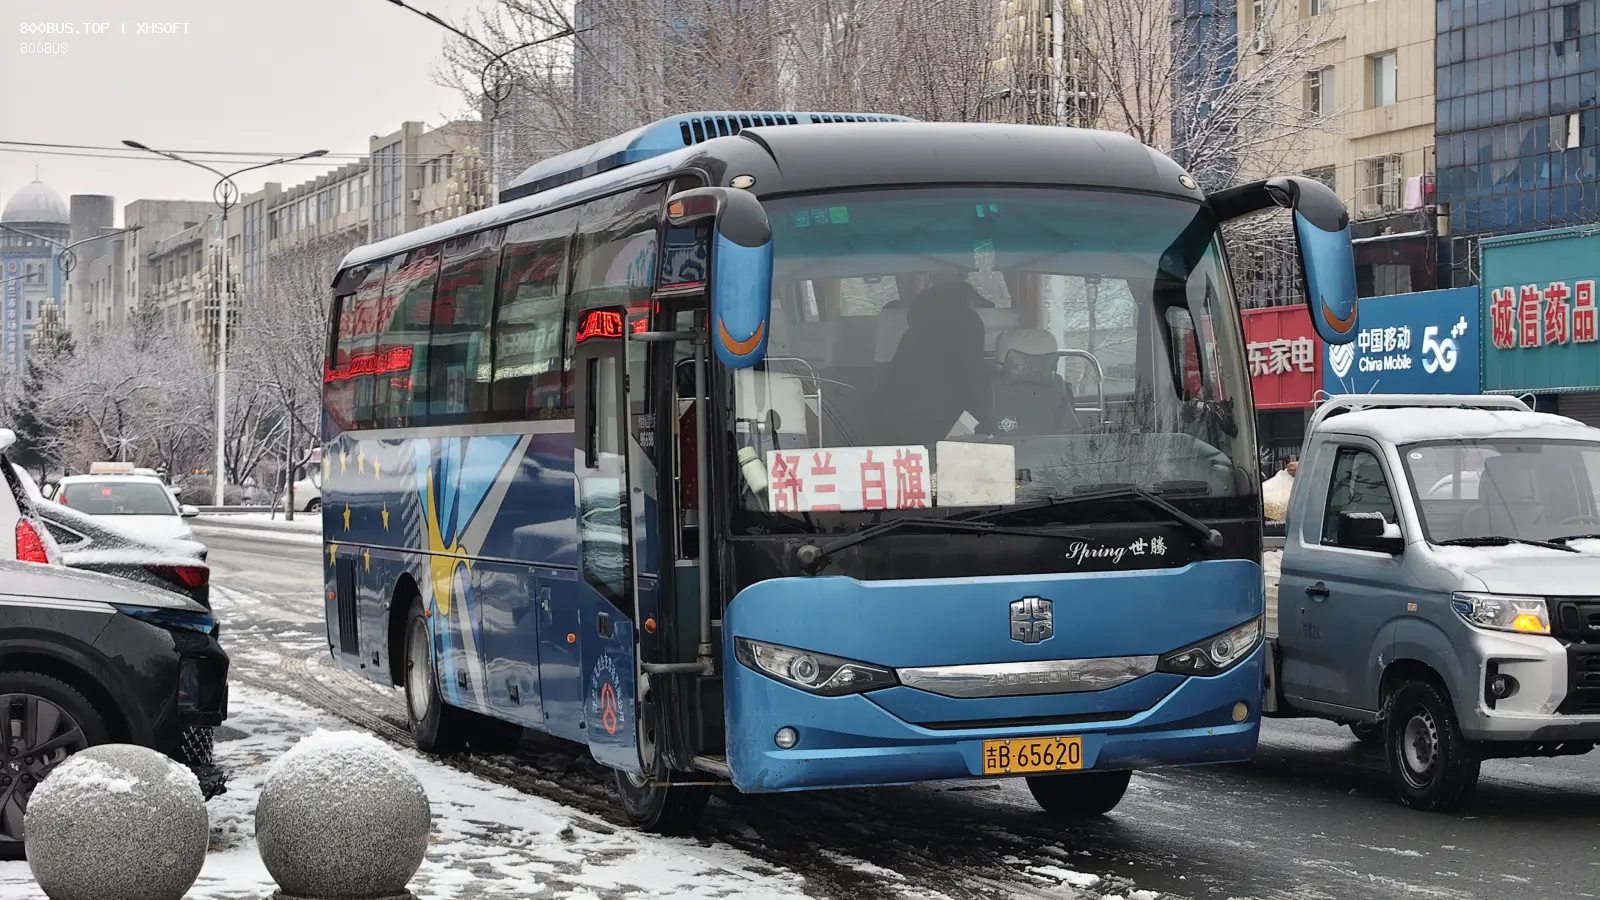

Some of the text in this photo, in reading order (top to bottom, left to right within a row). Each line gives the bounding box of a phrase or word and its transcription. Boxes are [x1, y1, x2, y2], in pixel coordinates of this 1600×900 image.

[1490, 279, 1598, 350] 诚信药品
[1358, 325, 1411, 353] 中国移动
[1358, 353, 1412, 373] China Mobile
[771, 448, 926, 512] 舒兰 白旗
[1065, 536, 1168, 565] Spring 世腾
